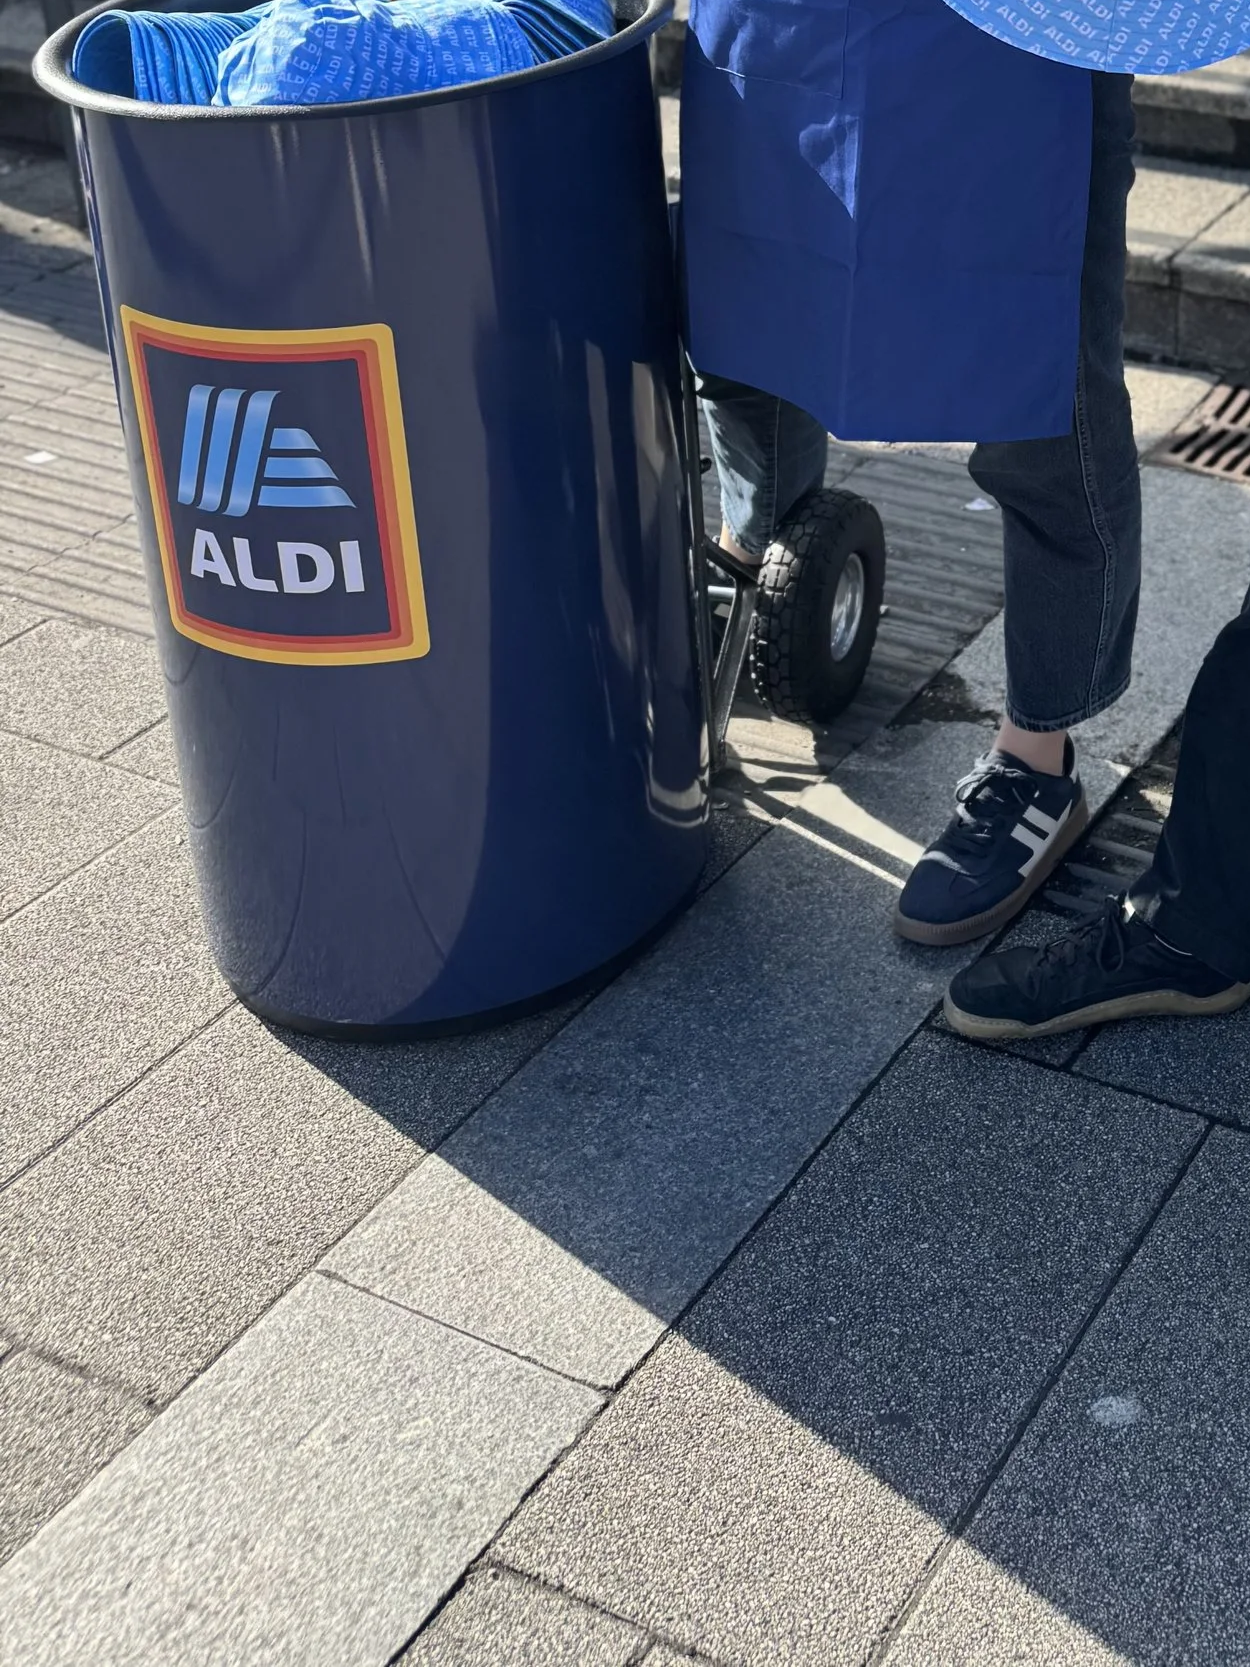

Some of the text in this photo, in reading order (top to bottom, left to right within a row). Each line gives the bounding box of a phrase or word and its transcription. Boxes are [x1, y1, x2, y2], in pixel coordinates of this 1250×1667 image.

[997, 5, 1034, 37] ALDI
[1060, 10, 1096, 38] ALDI
[1158, 3, 1184, 40] ALDI
[1177, 12, 1200, 50] ALDI
[1044, 26, 1080, 56] ALDI
[1193, 22, 1217, 59] ALDI
[190, 528, 365, 593] ALDI
